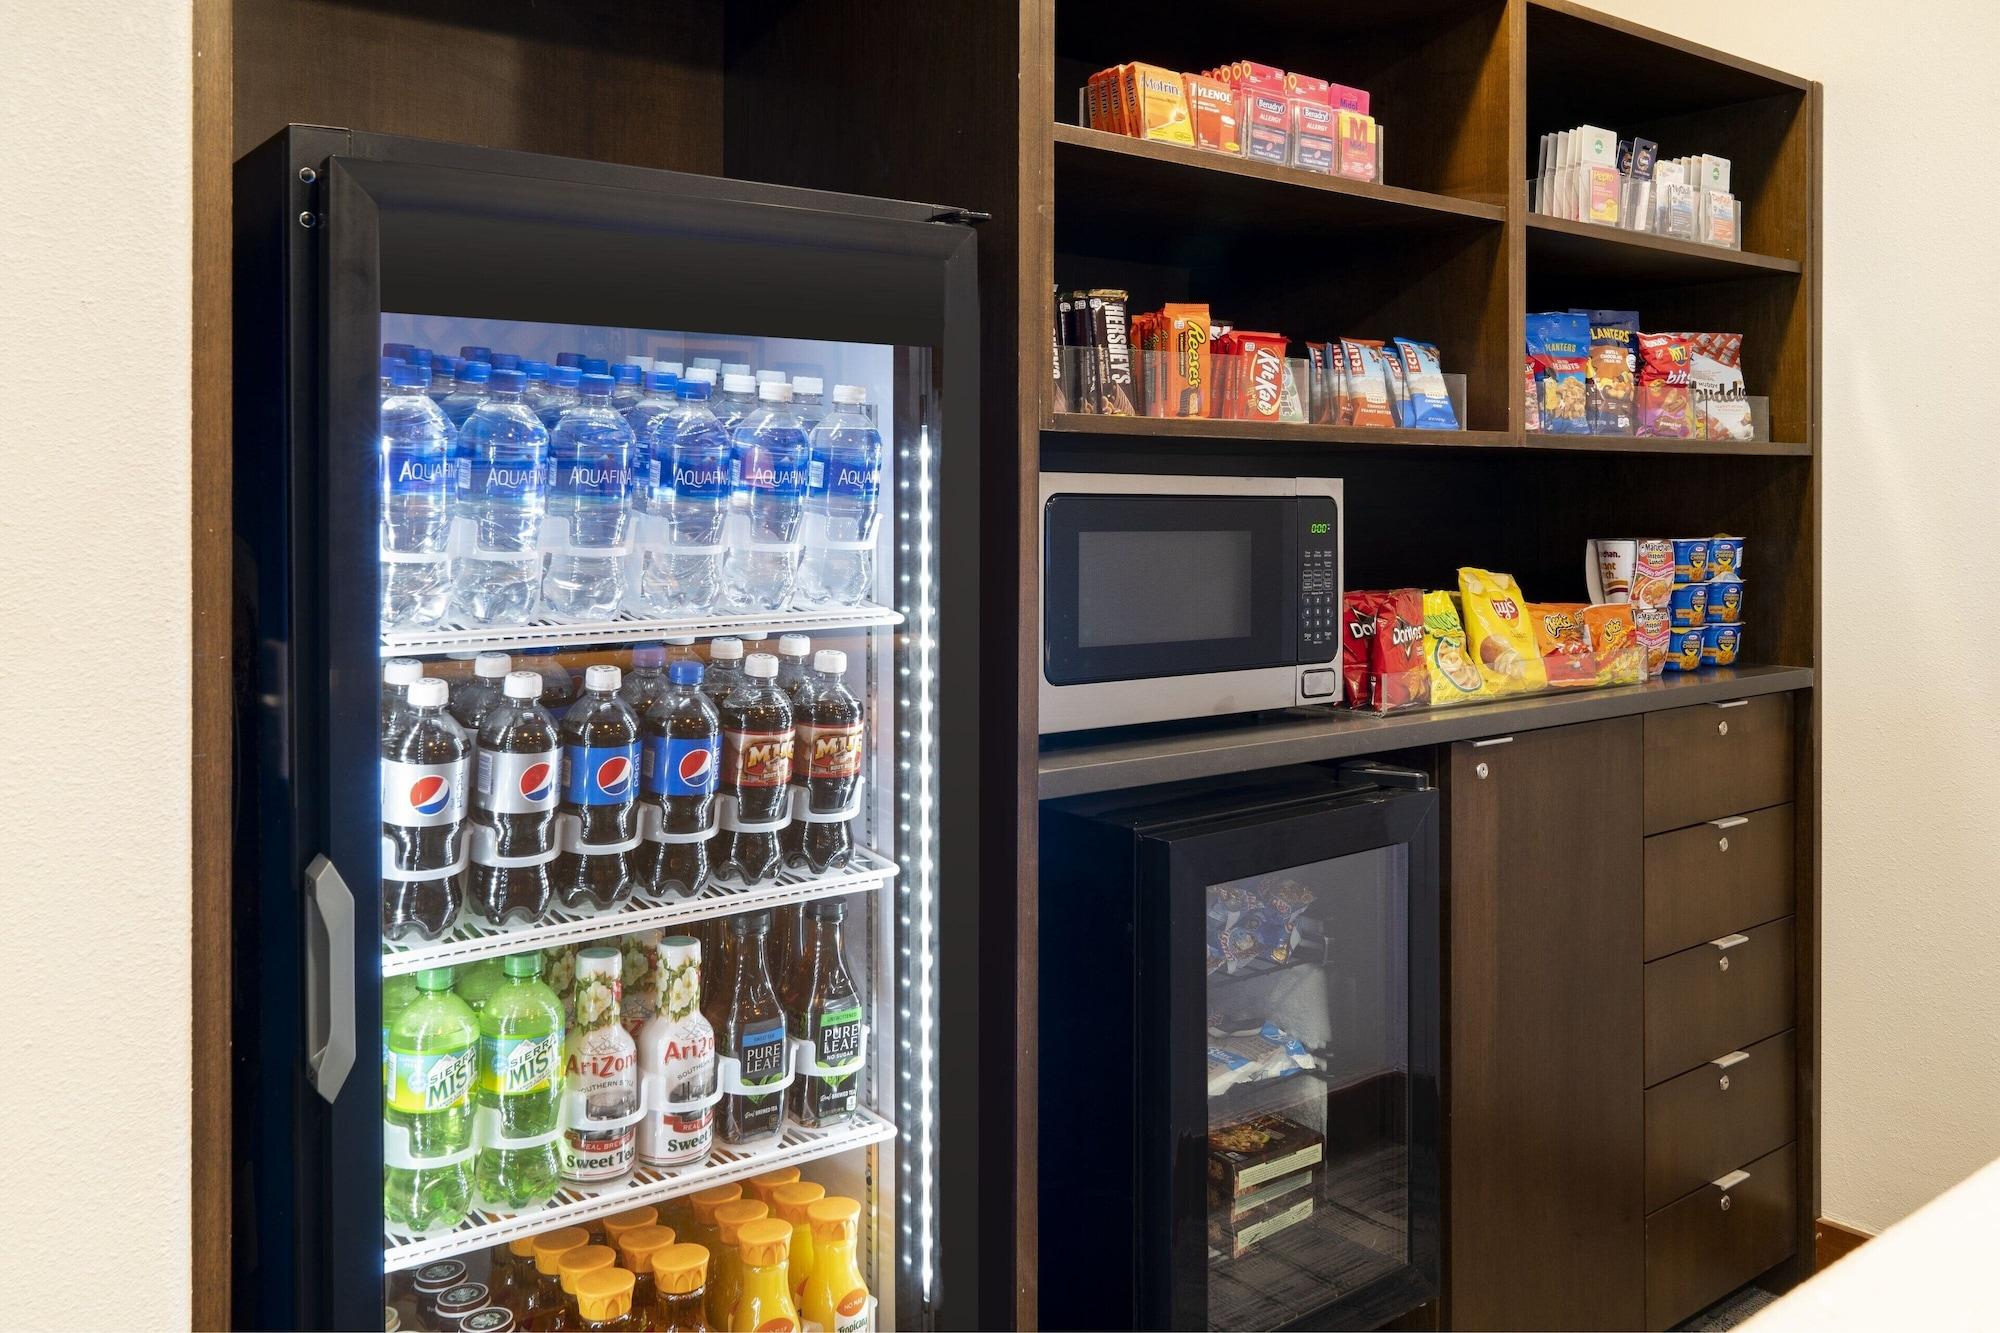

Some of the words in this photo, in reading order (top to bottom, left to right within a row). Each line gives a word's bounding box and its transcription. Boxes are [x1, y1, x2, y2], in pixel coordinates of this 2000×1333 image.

[1141, 77, 1179, 96] Motrin
[1190, 83, 1232, 104] TYLENOL
[1258, 99, 1285, 114] Benadryl
[1304, 108, 1330, 121] Benadryl
[1105, 302, 1131, 384] HERSHEY'S
[1590, 327, 1630, 343] LANTERS
[1187, 320, 1206, 388] Reese's
[399, 459, 458, 482] AQUAFIN
[1645, 543, 1673, 552] Maruchan
[824, 1023, 859, 1042] PURE
[510, 1033, 557, 1067] SIERRA
[664, 1034, 715, 1065] AriZo
[747, 1043, 782, 1061] PURE
[823, 1036, 859, 1054] LEAF
[836, 1050, 854, 1059] SUGAR
[509, 1044, 557, 1090] MIST
[746, 1055, 780, 1074] LEAF
[428, 1055, 476, 1107] MIST
[667, 1132, 708, 1153] Sweet
[566, 1154, 613, 1169] Sweet
[616, 1148, 635, 1165] Tea
